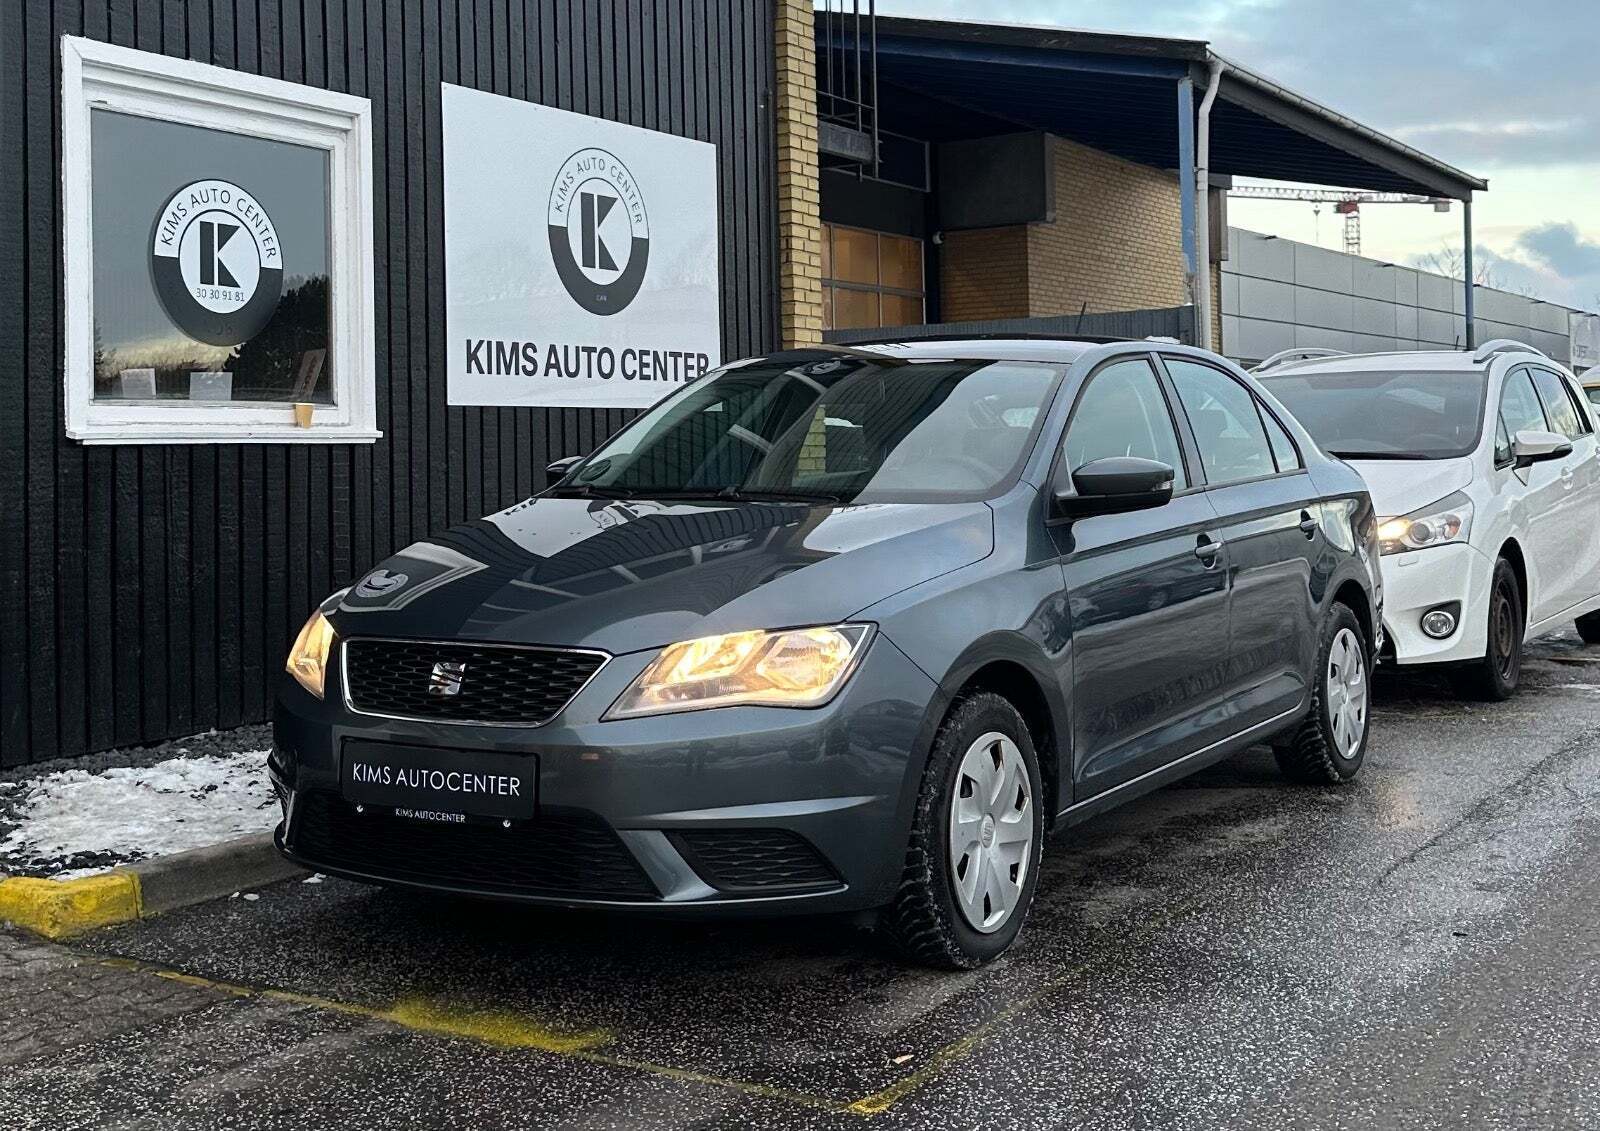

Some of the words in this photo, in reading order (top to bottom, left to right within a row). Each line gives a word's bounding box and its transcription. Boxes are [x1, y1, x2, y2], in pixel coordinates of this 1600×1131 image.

[555, 171, 575, 213] KIMS
[577, 157, 605, 174] AUTO
[610, 165, 643, 224] CENTER
[160, 202, 188, 246] KIMS
[190, 188, 231, 208] AUTO
[236, 198, 277, 259] CENTER
[580, 191, 620, 272] K
[199, 220, 241, 289] K
[196, 287, 207, 299] 30
[209, 288, 220, 300] 30
[221, 290, 232, 301] 91
[234, 291, 245, 302] 81
[466, 338, 539, 377] KIMS
[543, 343, 615, 380] AUTO
[620, 348, 710, 382] CENTER
[352, 762, 391, 785] KIMS
[395, 767, 521, 797] AUTOCENTER
[395, 807, 413, 819] KIMS
[414, 811, 466, 824] AUTOCENTER
